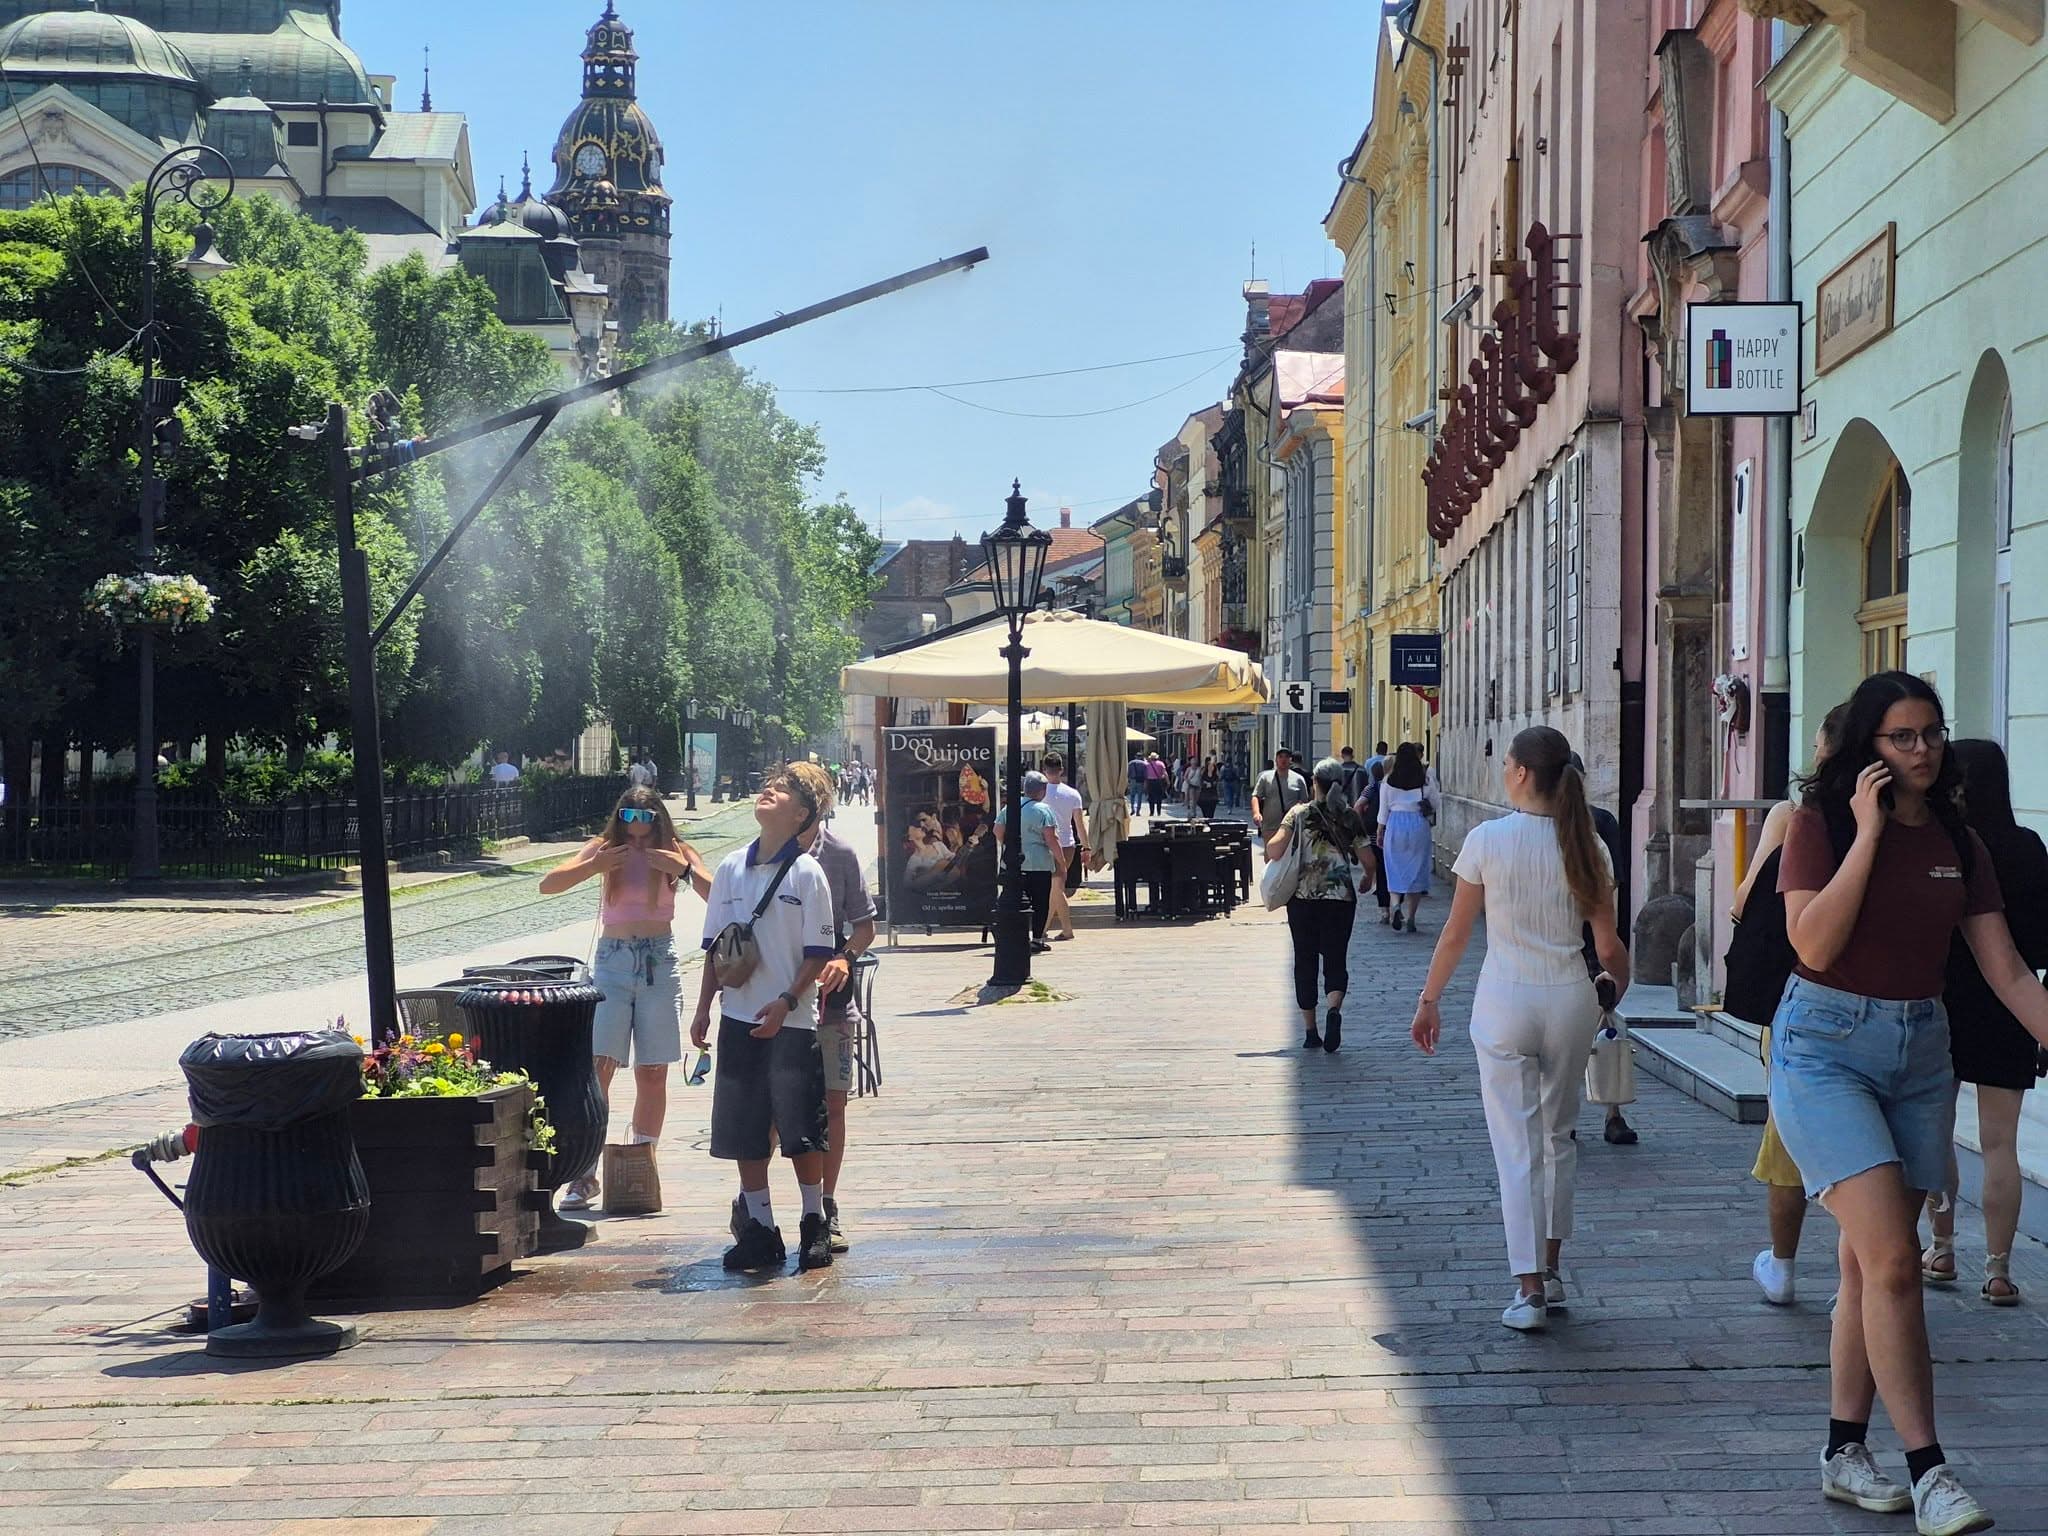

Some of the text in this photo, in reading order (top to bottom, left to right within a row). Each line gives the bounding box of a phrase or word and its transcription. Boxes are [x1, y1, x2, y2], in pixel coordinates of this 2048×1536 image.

[1737, 338, 1778, 358] HAPPY
[1737, 369, 1784, 389] BOTTLE
[890, 733, 934, 751] Don
[914, 743, 991, 767] Quijote
